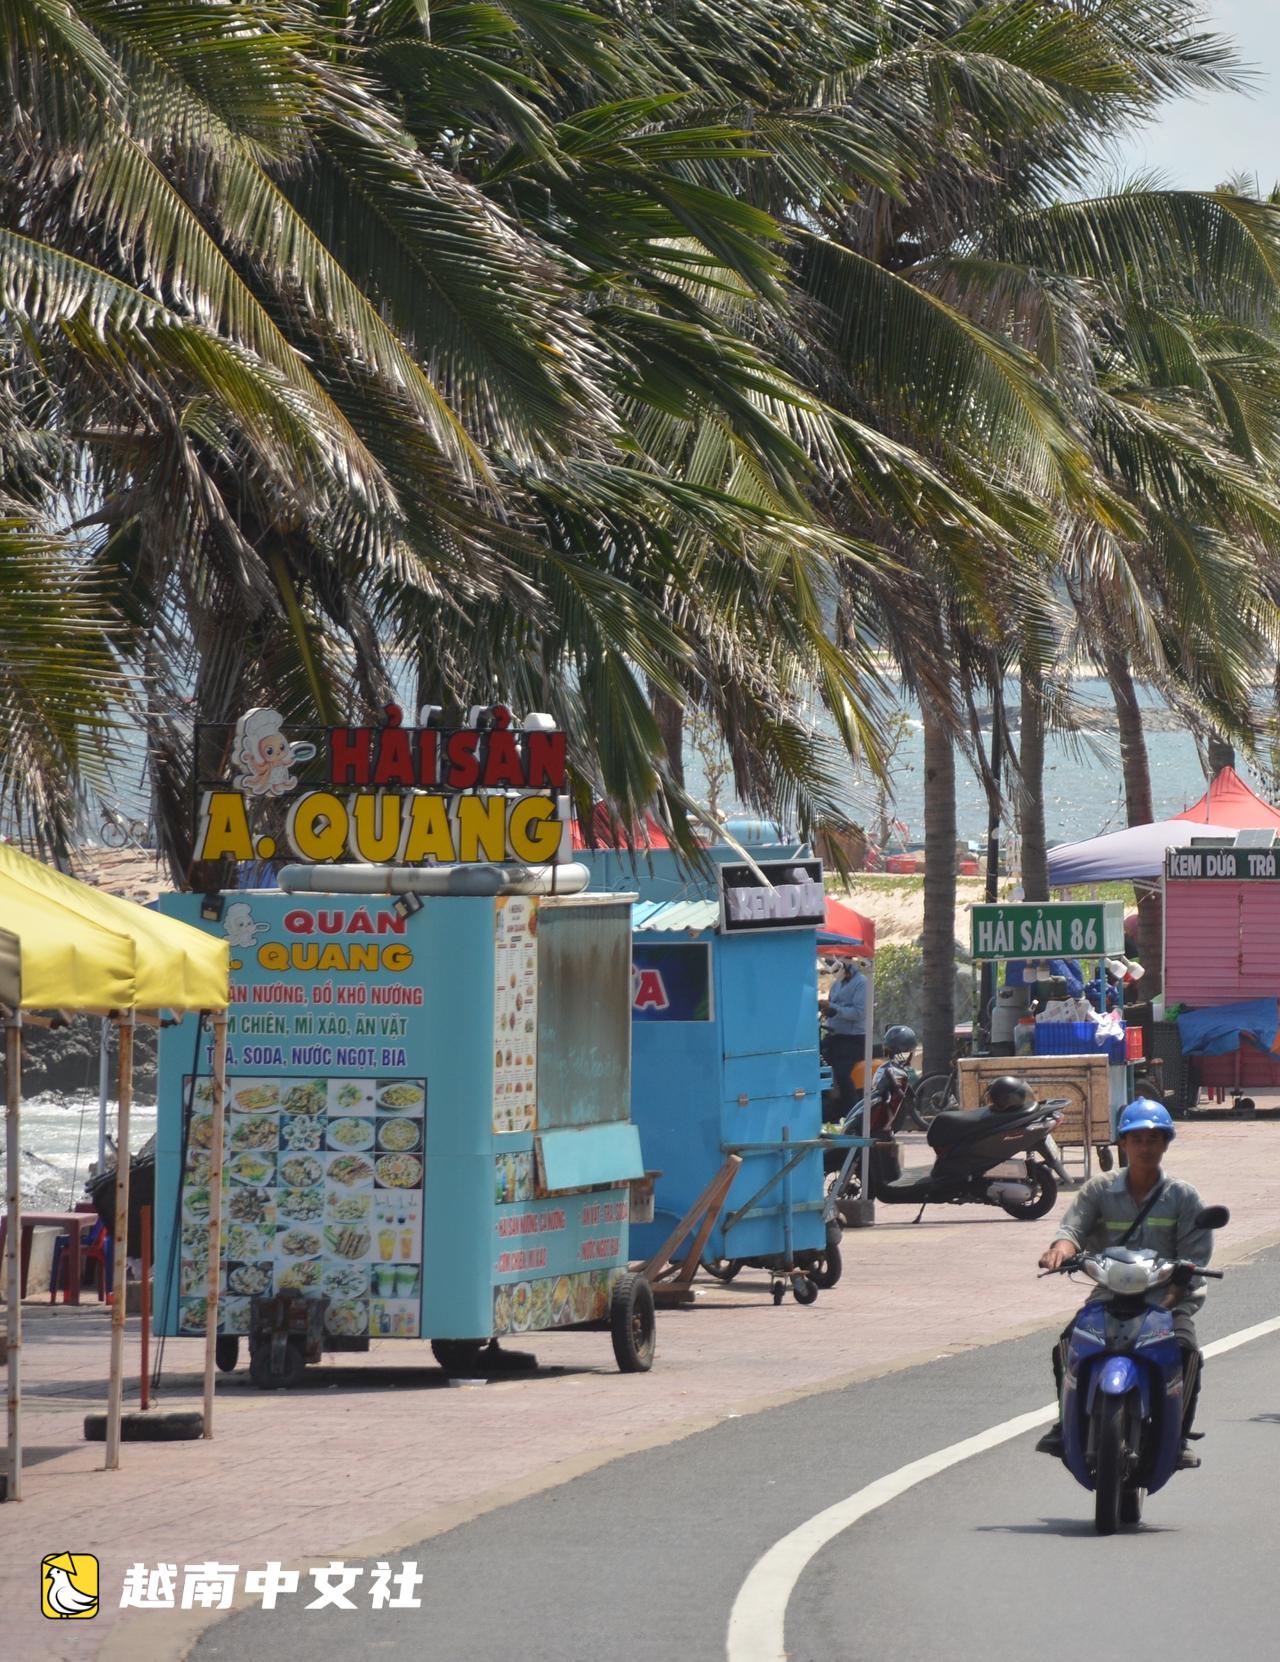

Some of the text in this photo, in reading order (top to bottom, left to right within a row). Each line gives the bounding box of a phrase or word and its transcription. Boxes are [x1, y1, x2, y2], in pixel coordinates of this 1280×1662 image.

[329, 702, 567, 789] HẢI SẢN
[199, 790, 563, 863] A. QUANG
[1170, 853, 1202, 877] KEM
[1247, 850, 1276, 877] TRÀ
[284, 906, 407, 935] QUÁN
[978, 908, 1097, 952] HẢI SẢN 86
[257, 941, 415, 973] QUANG
[253, 982, 308, 1006] NƯỚNG,
[337, 984, 367, 1006] KHÔ
[371, 984, 423, 1006] NƯỚNG
[241, 1012, 289, 1035] CHIÊN,
[295, 1013, 313, 1035] MÌ
[318, 1013, 350, 1036] XÀO,
[356, 1013, 377, 1036] ĂN
[380, 1013, 407, 1040] VẶT
[243, 1045, 287, 1066] SODA,
[292, 1043, 332, 1066] NƯỚC
[336, 1046, 377, 1070] NGỌT,
[382, 1048, 407, 1067] BIA
